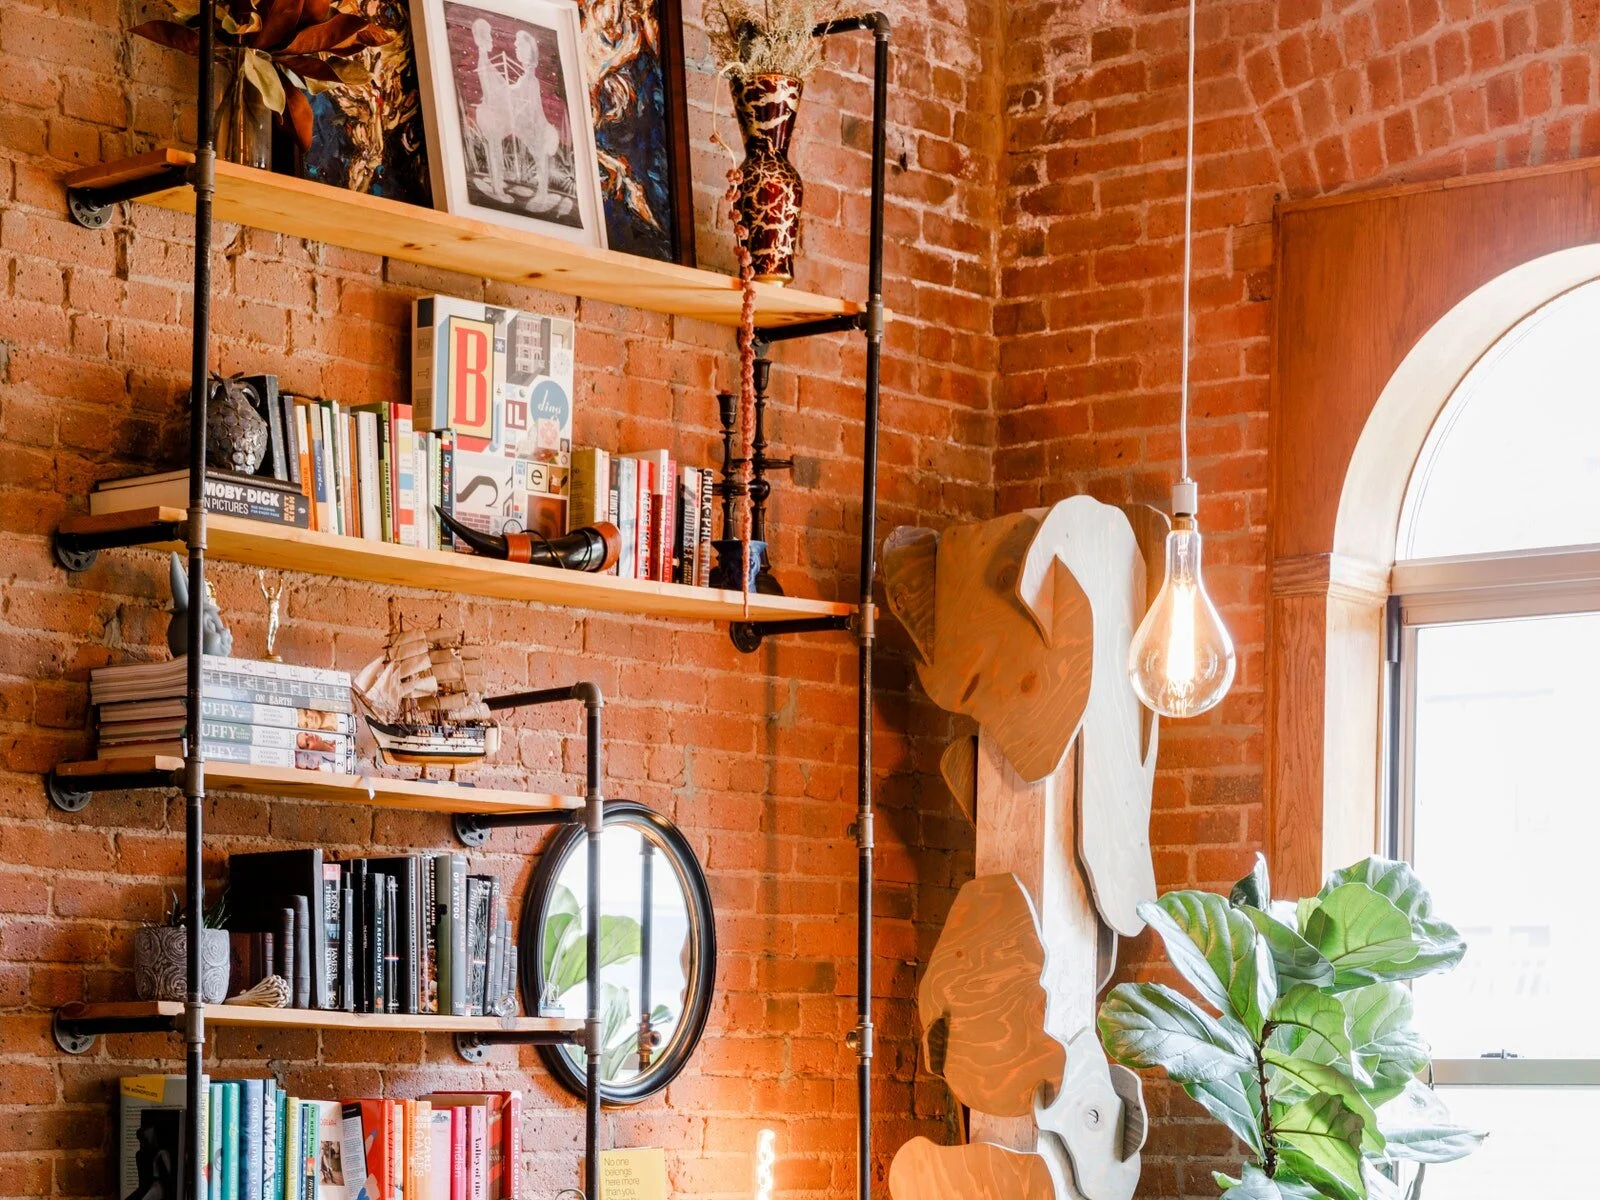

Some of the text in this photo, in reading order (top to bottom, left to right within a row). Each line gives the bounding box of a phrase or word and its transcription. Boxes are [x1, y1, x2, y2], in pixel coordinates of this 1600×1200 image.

[452, 326, 488, 428] B
[507, 402, 525, 427] IL
[531, 469, 543, 486] e
[204, 481, 280, 507] MOBY-DICK
[701, 467, 713, 512] CHUCK
[211, 498, 249, 515] PICTURES
[638, 491, 651, 577] PLEASE KILL ME
[683, 504, 696, 560] MIDDLESEX
[255, 693, 293, 706] ON EARTH
[202, 701, 237, 718] UFFY
[202, 722, 237, 740] UFFY
[453, 872, 459, 884] OF
[467, 888, 478, 948] Philip Larkin
[264, 1093, 276, 1181] ARMADA
[414, 1130, 424, 1177] GAMES
[424, 1136, 432, 1172] CARD
[474, 1137, 482, 1164] Valley
[604, 1157, 629, 1167] No one
[251, 1171, 258, 1184] TO
[475, 1167, 481, 1178] of
[605, 1167, 632, 1177] belongs
[605, 1177, 640, 1187] here more
[606, 1187, 621, 1197] than
